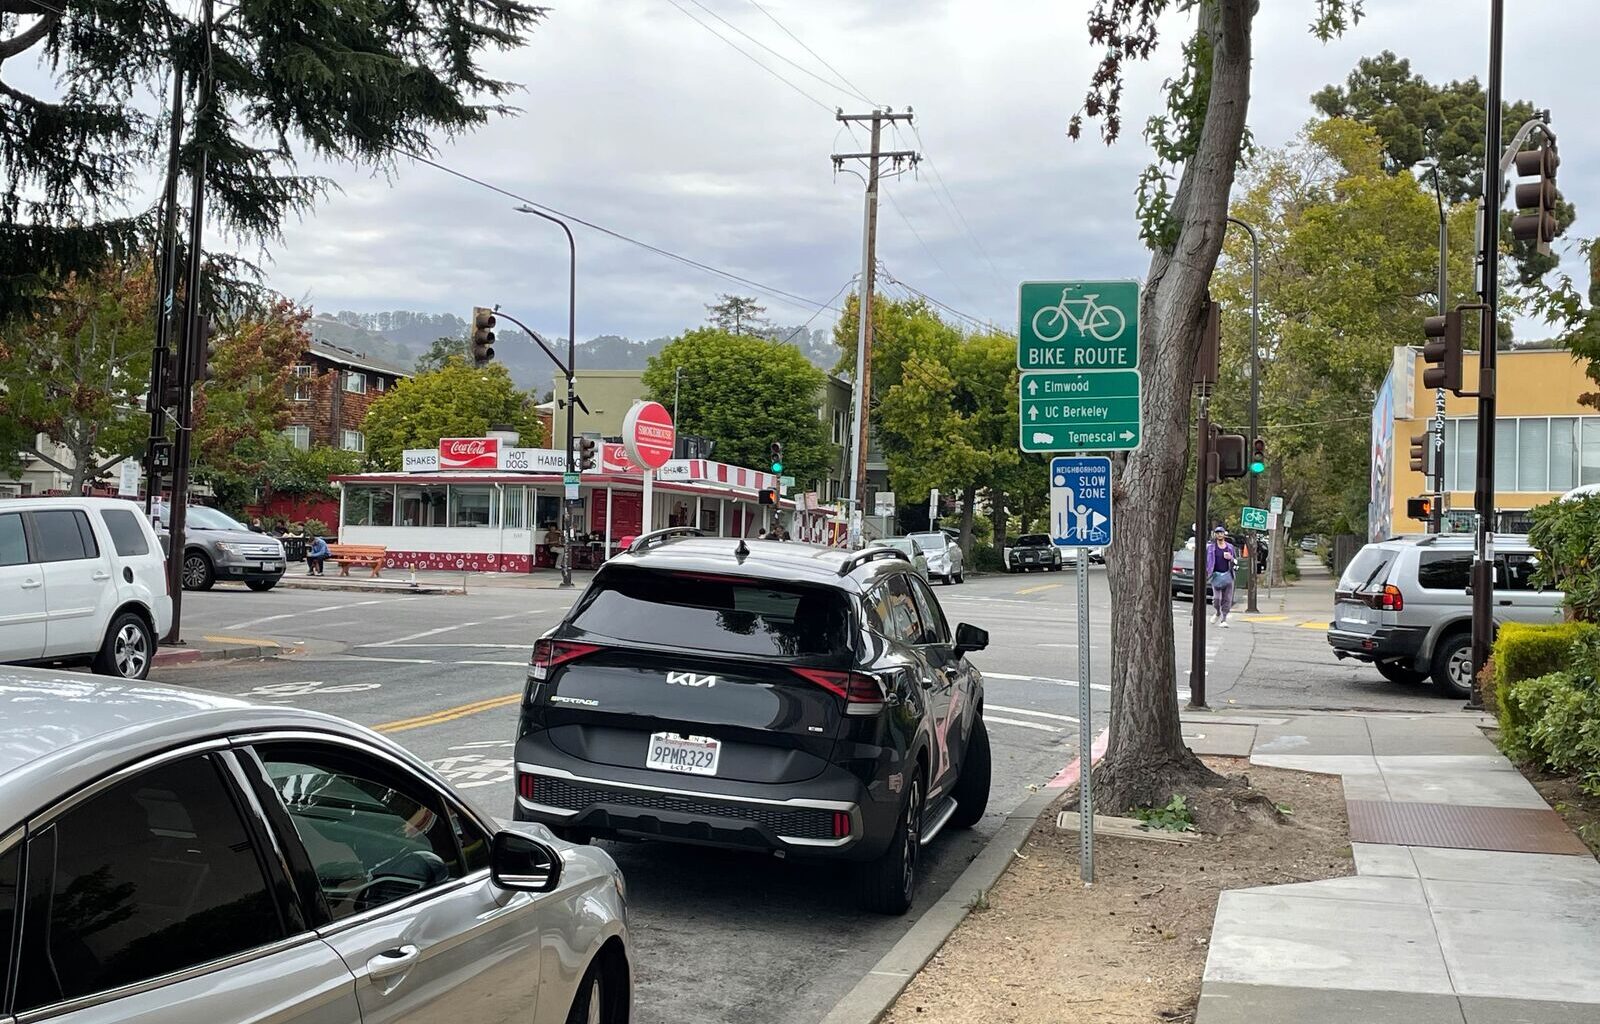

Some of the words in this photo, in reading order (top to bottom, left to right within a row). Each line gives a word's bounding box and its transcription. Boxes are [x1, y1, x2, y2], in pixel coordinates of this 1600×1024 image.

[1029, 348, 1065, 364] BIKE
[1075, 348, 1127, 365] ROUTE
[1044, 380, 1089, 392] Elmwood
[1045, 406, 1059, 418] UC
[1063, 405, 1108, 419] Berkeley
[1068, 430, 1116, 443] Temescal
[405, 455, 436, 465] SHAKES
[509, 451, 526, 460] HOT
[505, 460, 528, 469] DOGS
[1056, 466, 1106, 474] NEIGHBORHOOD
[1079, 475, 1106, 487] SLOW
[1079, 488, 1106, 499] ZONE
[666, 671, 716, 688] KIA
[550, 695, 600, 706] SPORTAGE
[655, 746, 714, 768] 9PMR329
